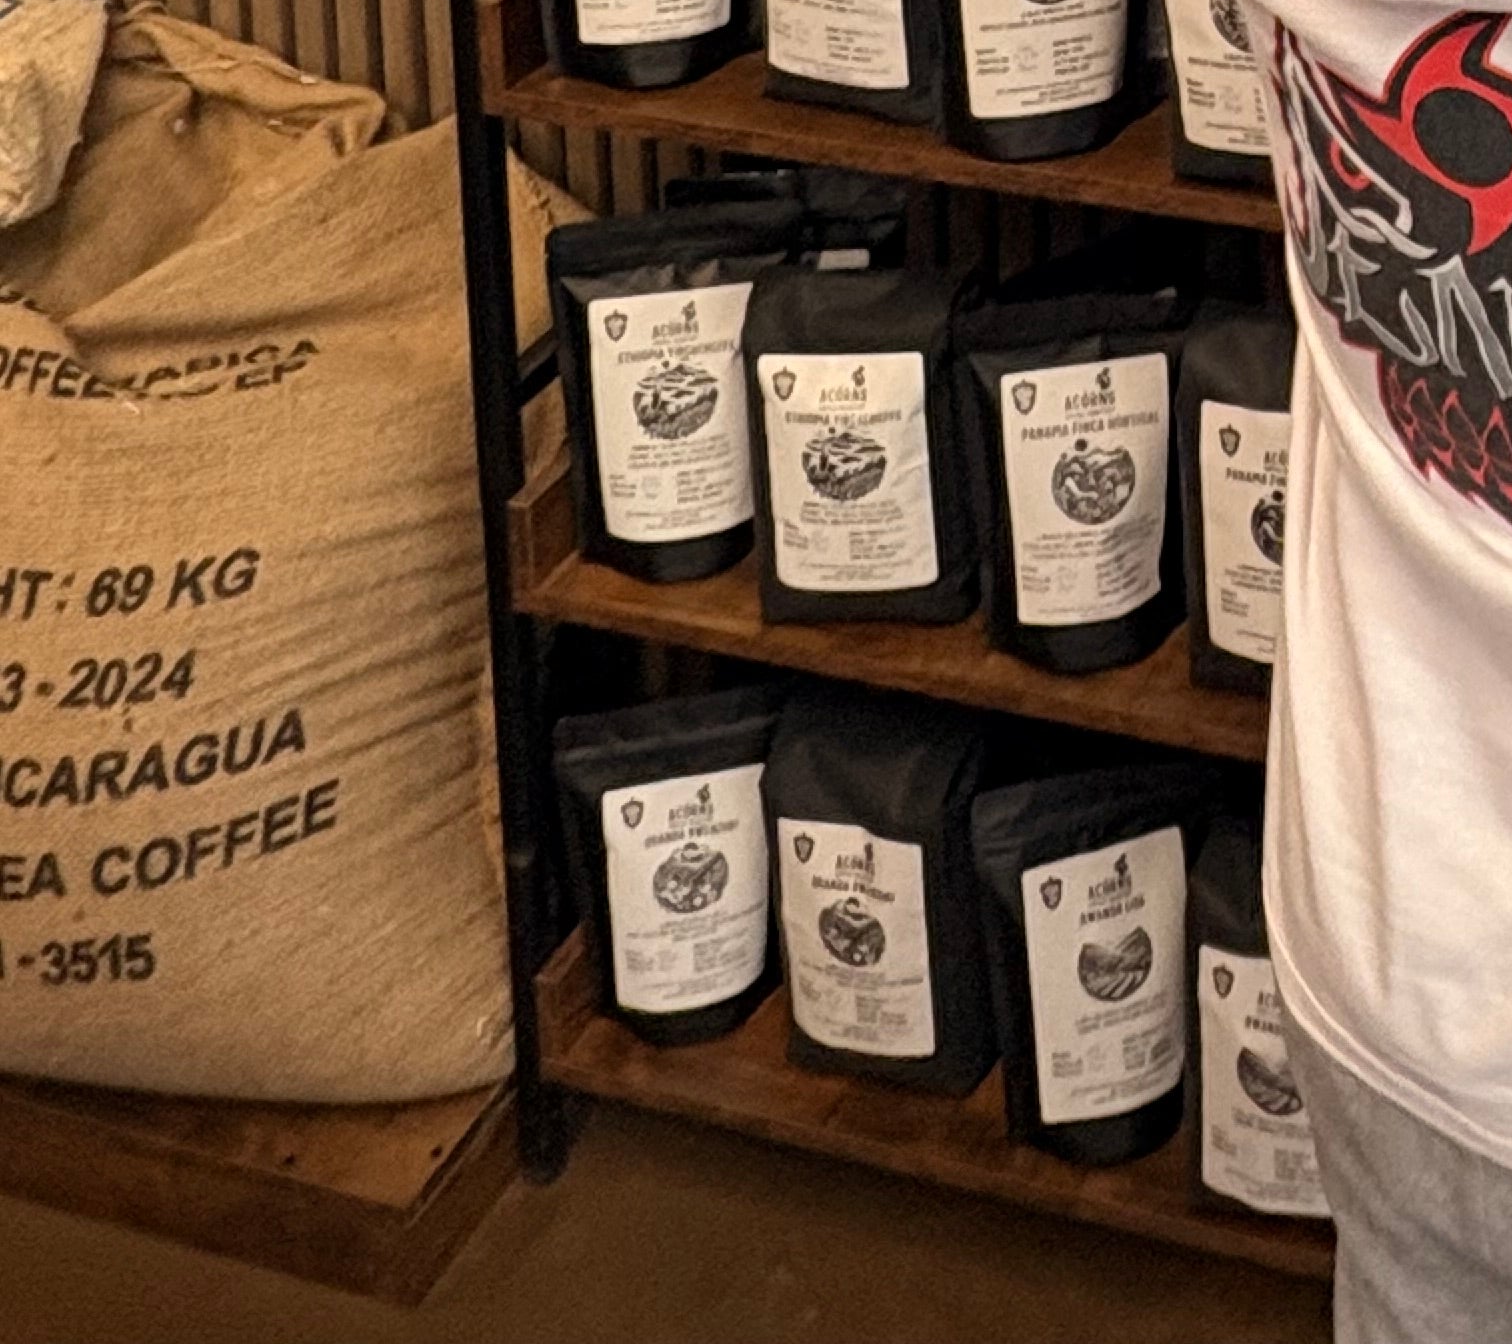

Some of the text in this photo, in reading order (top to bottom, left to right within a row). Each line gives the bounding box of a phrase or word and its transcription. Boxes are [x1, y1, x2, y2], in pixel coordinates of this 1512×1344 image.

[87, 564, 154, 617] 69
[166, 547, 260, 611] KG
[91, 779, 340, 896] COFFEE
